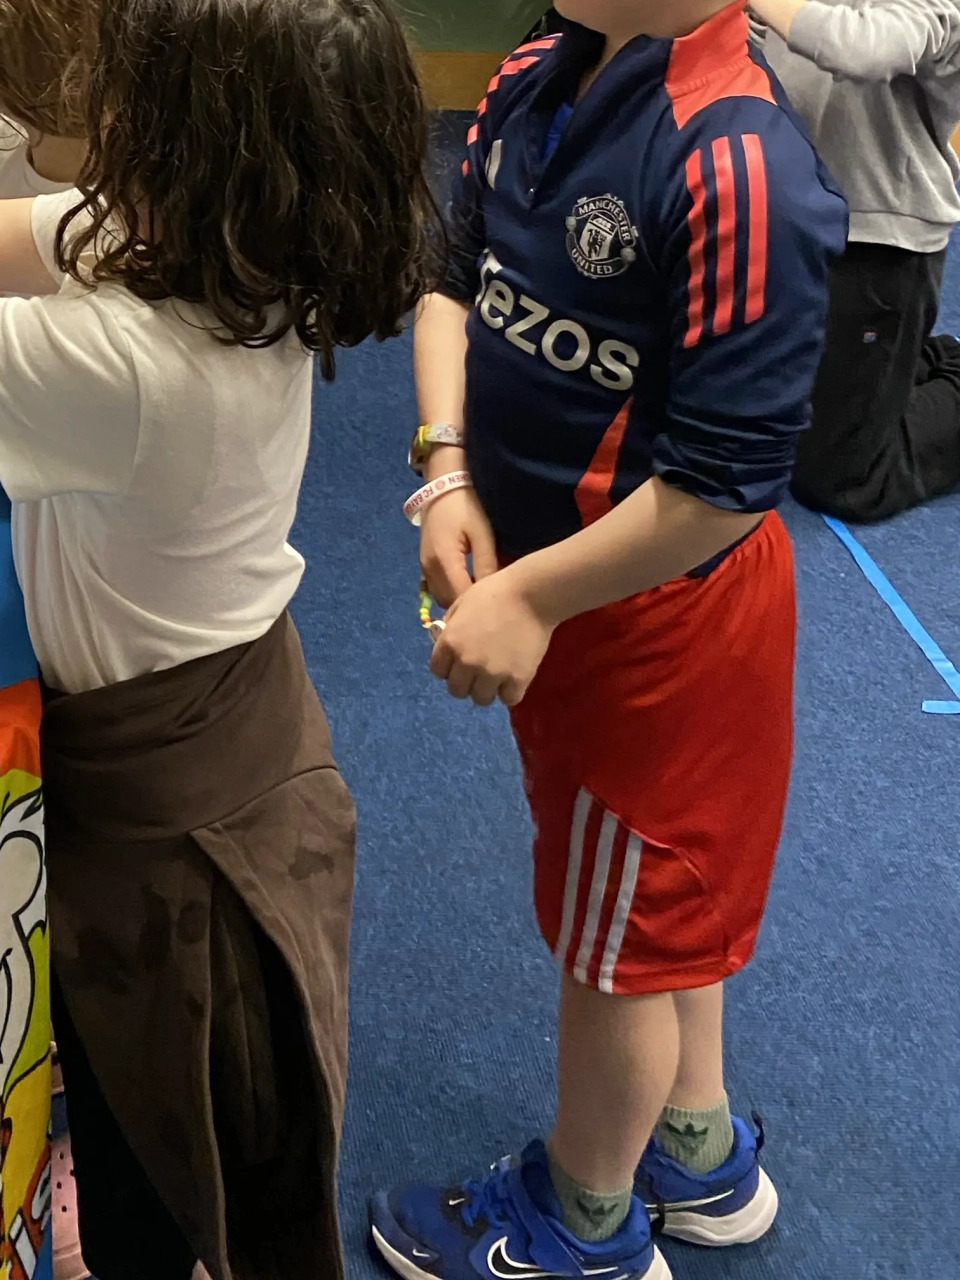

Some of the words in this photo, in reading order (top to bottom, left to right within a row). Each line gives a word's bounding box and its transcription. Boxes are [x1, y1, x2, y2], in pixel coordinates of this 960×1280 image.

[578, 199, 632, 240] MANCHESTER
[571, 248, 613, 275] UNITED
[422, 485, 434, 498] FC
